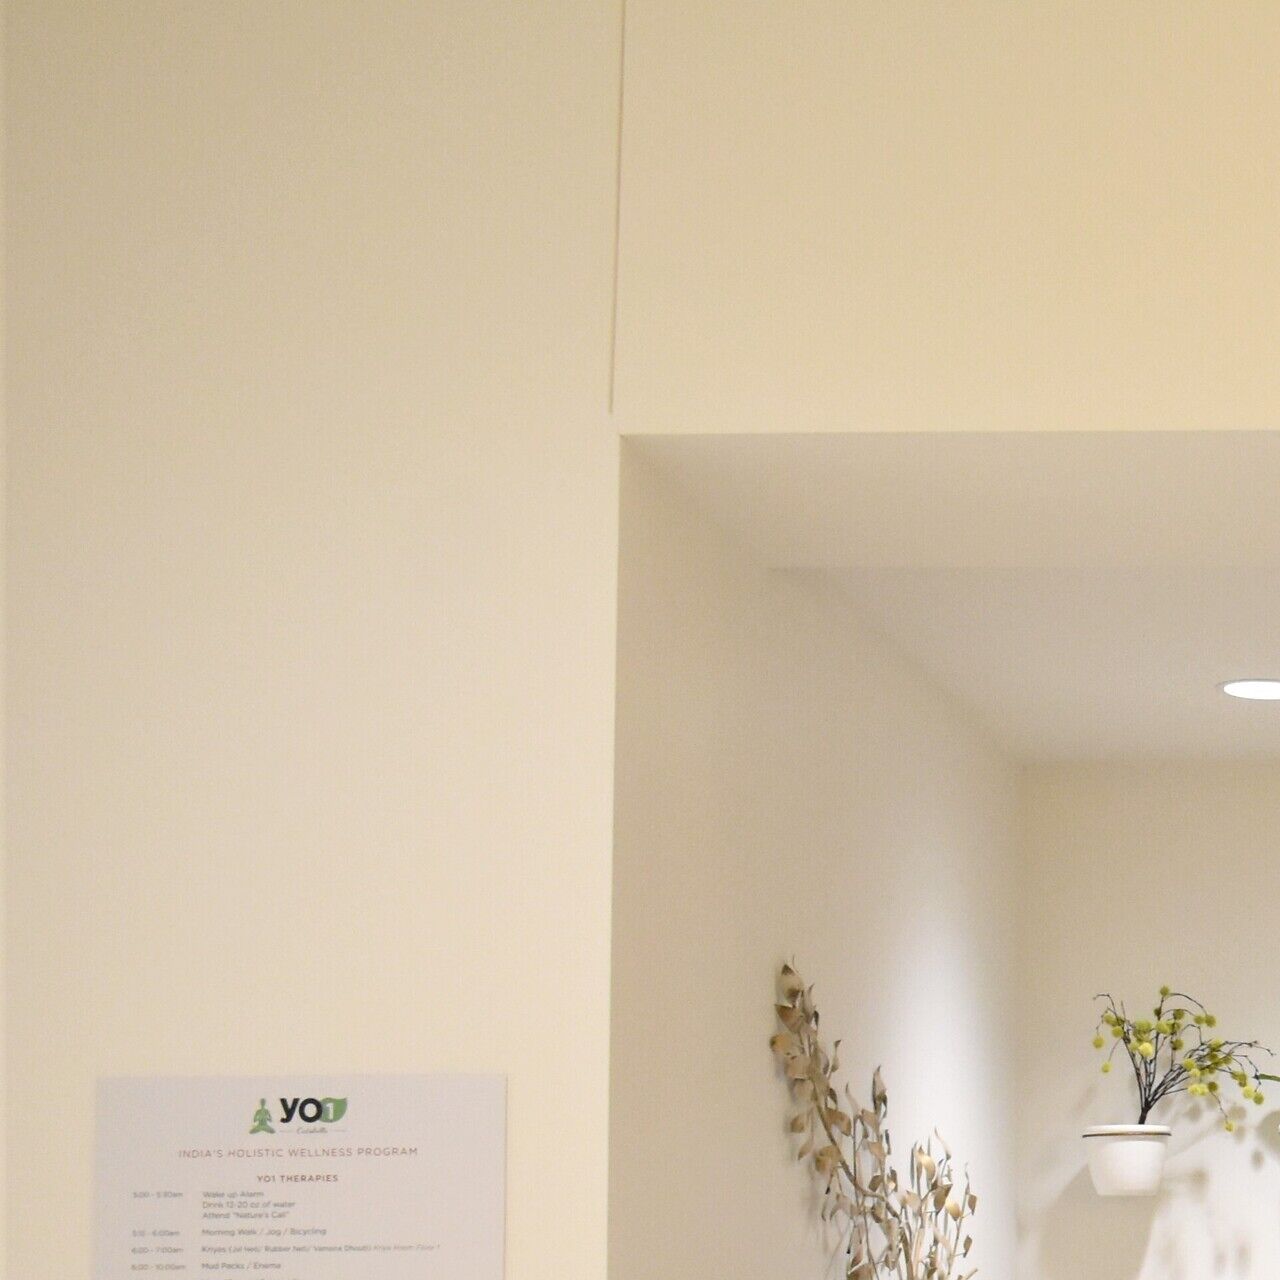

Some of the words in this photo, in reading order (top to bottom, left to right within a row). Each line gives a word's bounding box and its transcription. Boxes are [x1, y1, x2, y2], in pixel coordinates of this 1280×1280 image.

[178, 1149, 224, 1159] INDIA'S
[227, 1148, 284, 1158] HOLISTIC
[288, 1147, 353, 1158] WELLNESS
[357, 1147, 418, 1156] PROGRAM
[257, 1175, 276, 1183] YO1
[280, 1174, 338, 1182] THERAPIES
